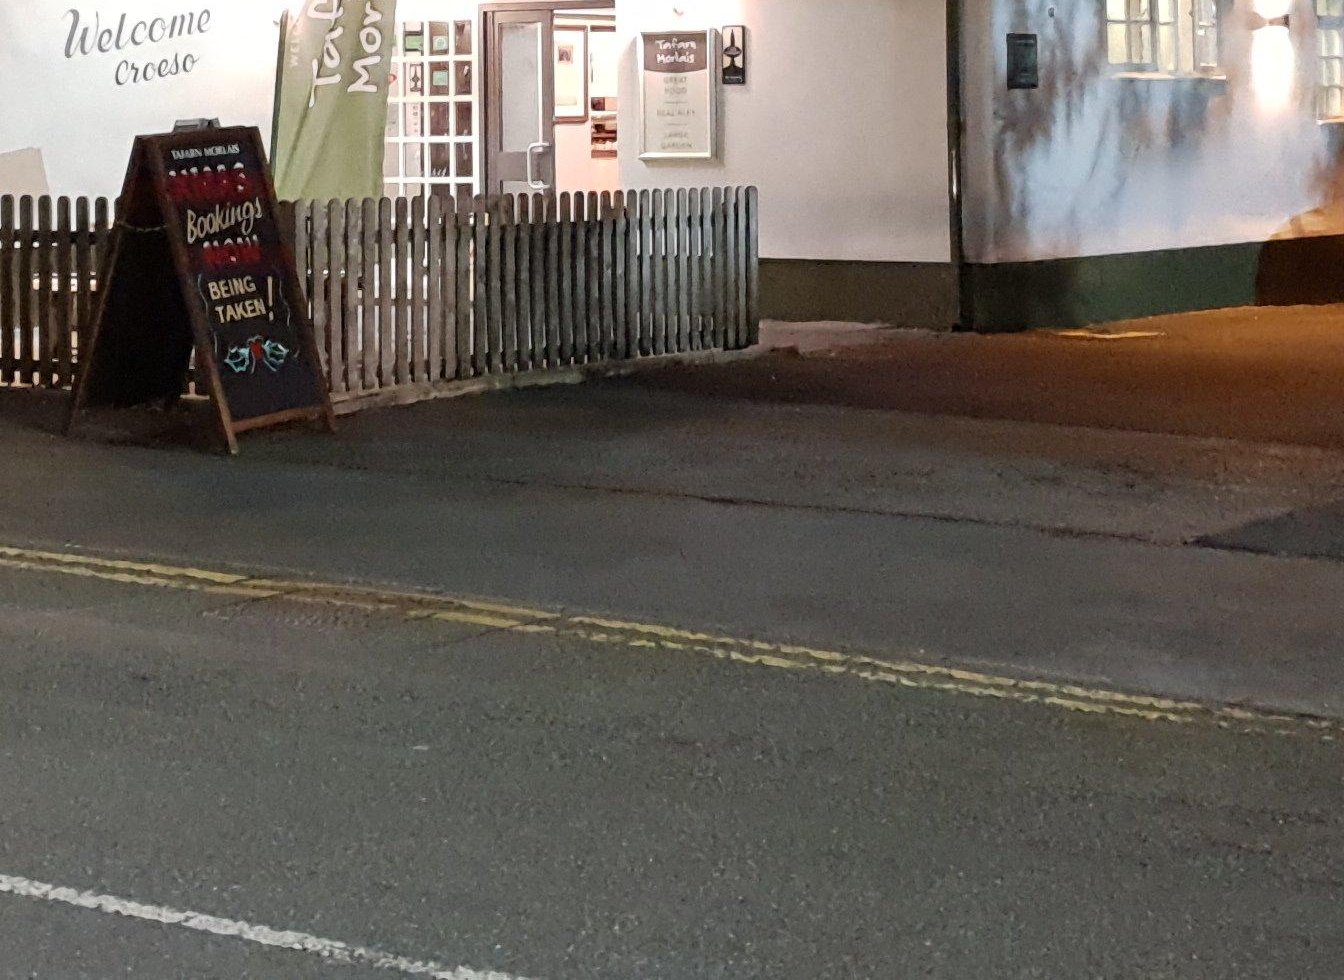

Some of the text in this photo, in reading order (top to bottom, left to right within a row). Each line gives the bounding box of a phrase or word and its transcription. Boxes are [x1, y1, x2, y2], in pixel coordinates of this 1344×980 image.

[61, 8, 212, 59] Welcome
[186, 196, 263, 245] Bookings
[208, 275, 257, 301] BEING
